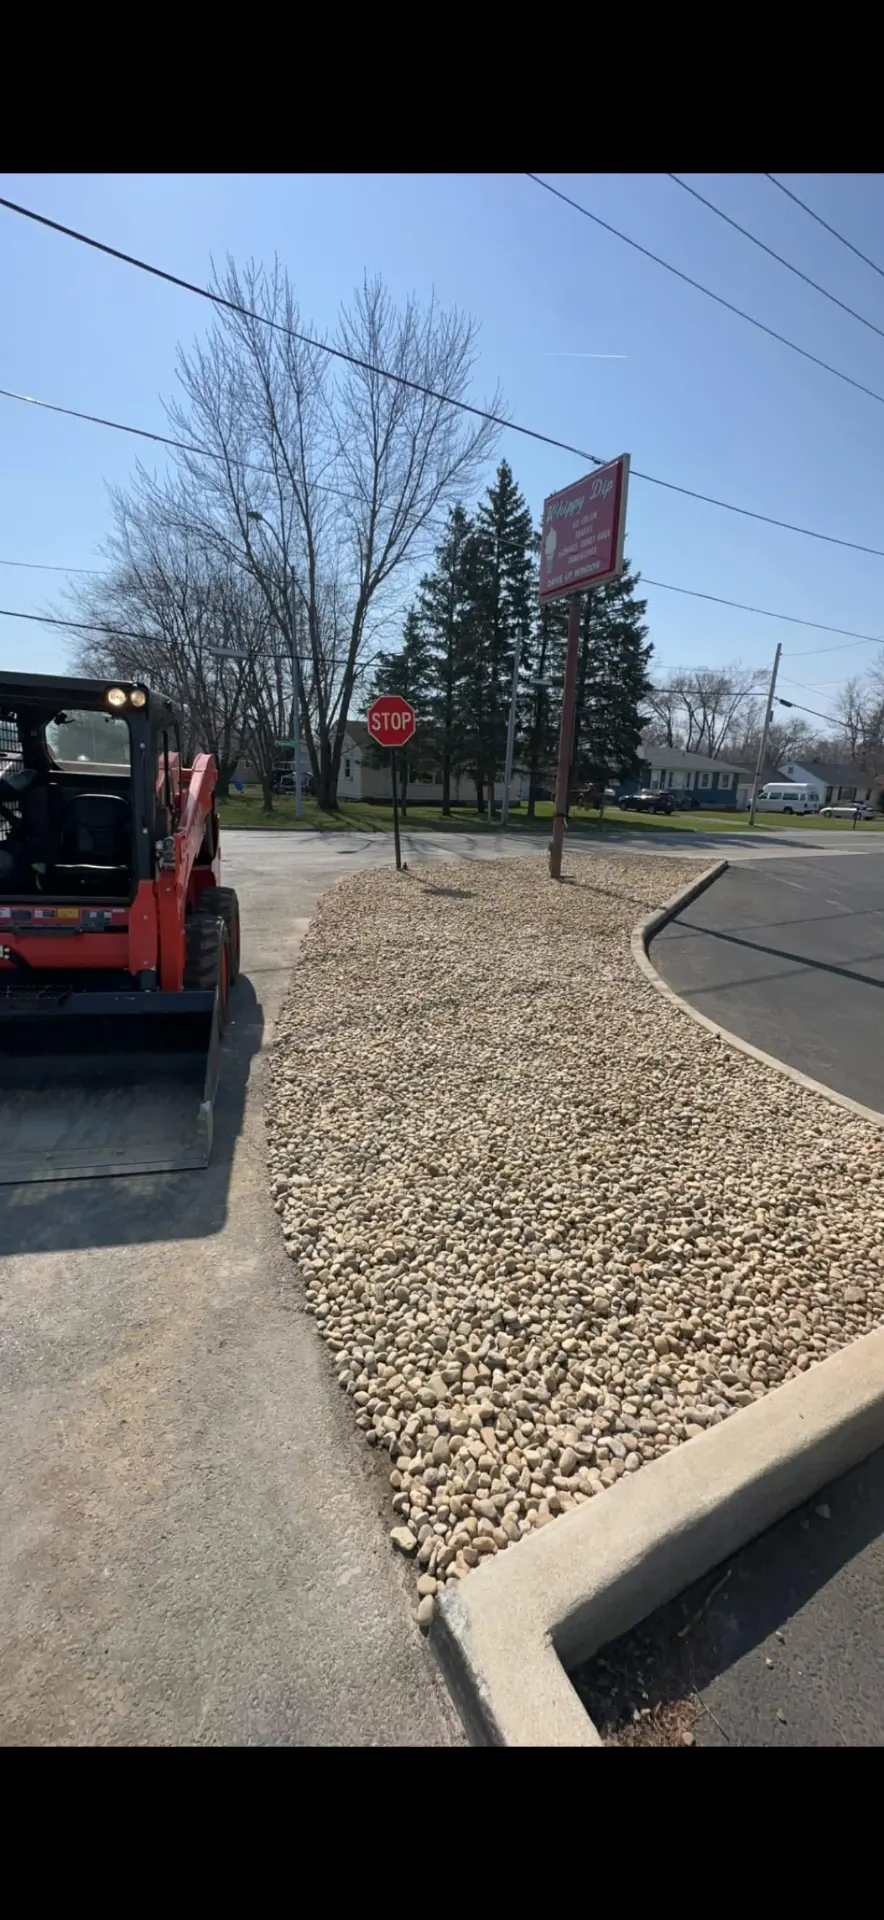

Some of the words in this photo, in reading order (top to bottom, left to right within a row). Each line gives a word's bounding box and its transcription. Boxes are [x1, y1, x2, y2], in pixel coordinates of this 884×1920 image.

[547, 492, 584, 523] Whippy
[590, 478, 614, 500] Dip
[546, 573, 563, 588] DRIVE
[564, 569, 573, 582] UP
[574, 560, 601, 579] WINDOW
[371, 712, 412, 732] STOP
